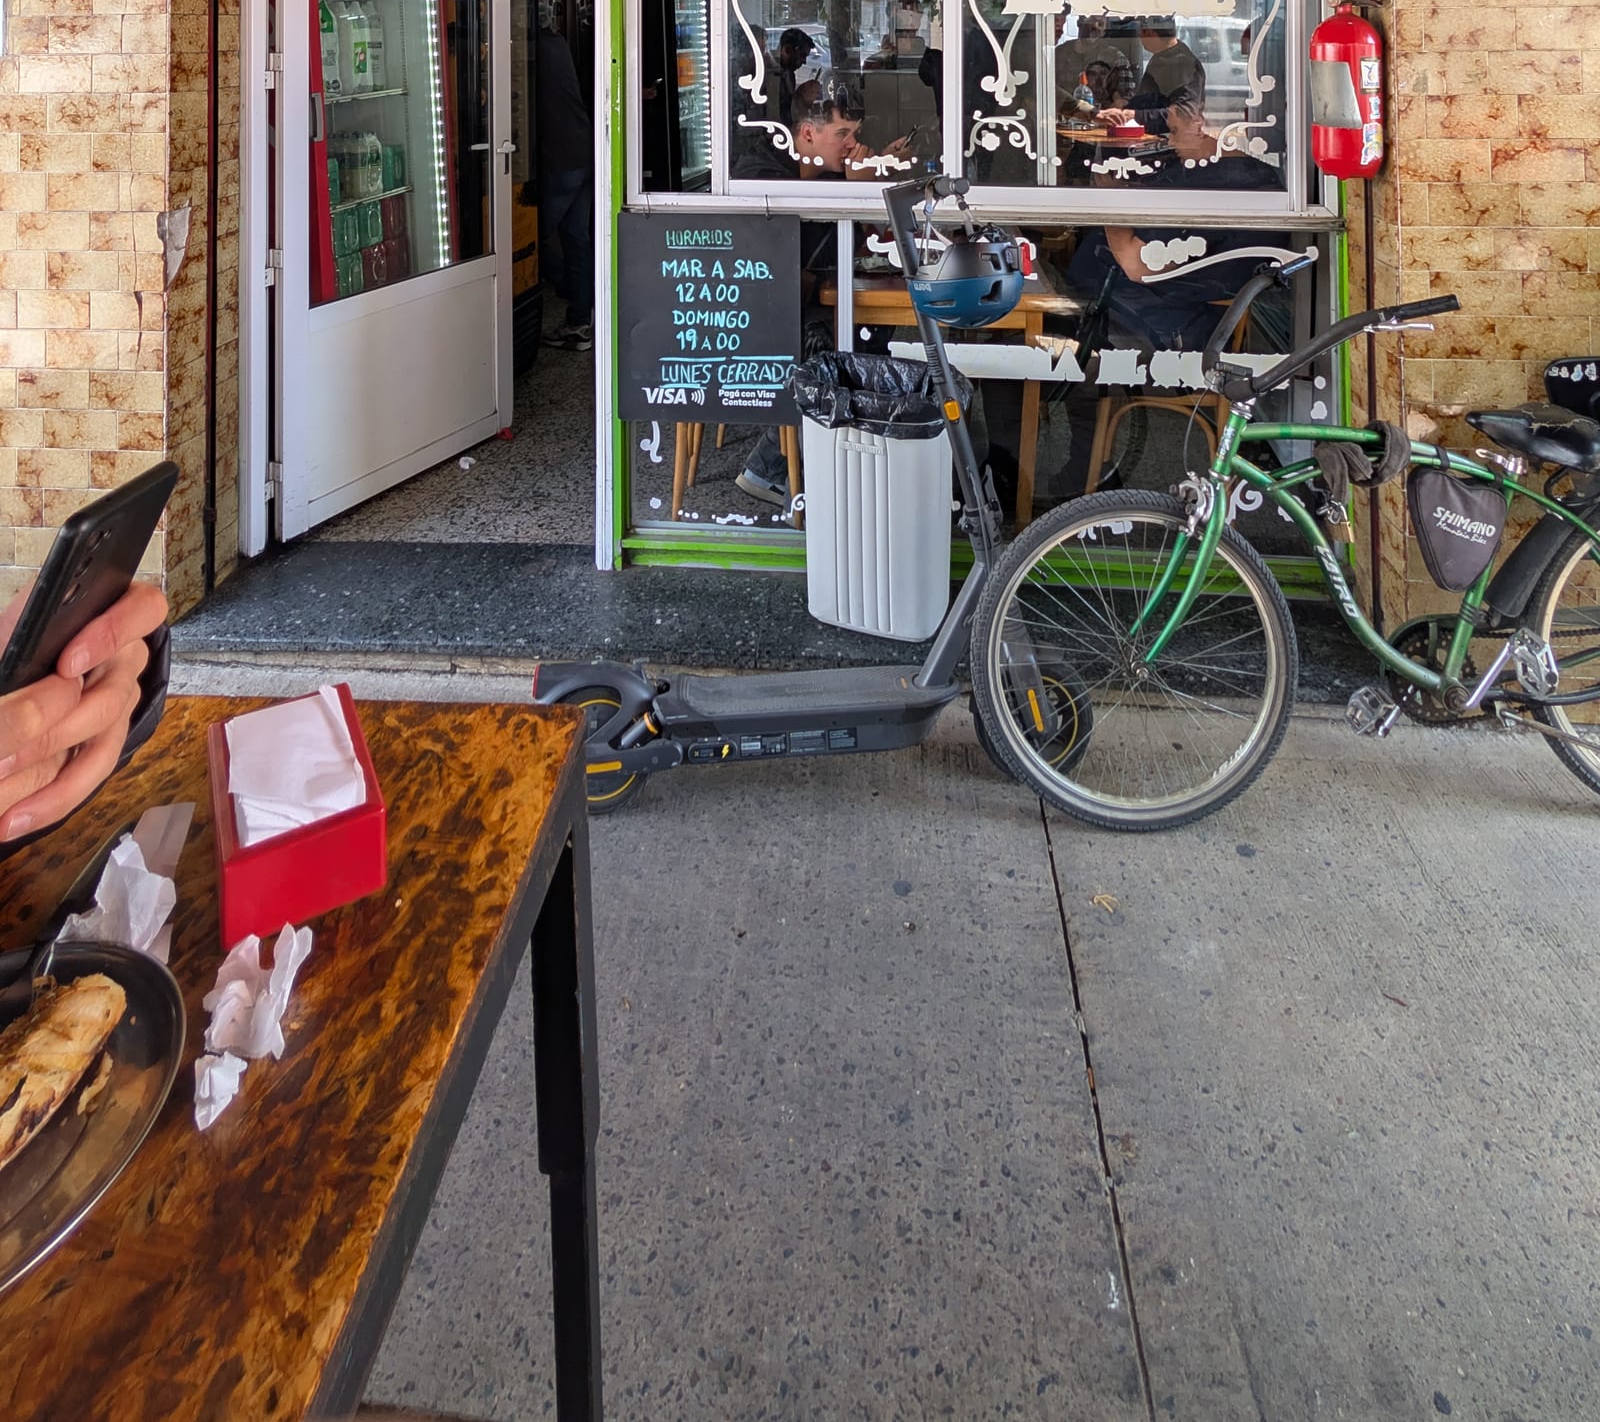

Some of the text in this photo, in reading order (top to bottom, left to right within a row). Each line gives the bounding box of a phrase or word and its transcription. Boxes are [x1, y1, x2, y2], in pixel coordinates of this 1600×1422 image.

[665, 230, 733, 246] HORARIOS
[661, 258, 774, 280] MAR A SAB.
[675, 283, 740, 303] 12 A 00
[672, 310, 750, 328] DOMINGO
[676, 329, 740, 350] 19 A 00
[661, 364, 712, 384] LUNES
[641, 387, 688, 405] VISA
[718, 389, 740, 399] Pagá
[757, 390, 776, 399] Visa
[722, 398, 772, 407] Contactless
[1432, 506, 1496, 537] SHIMANO
[1436, 520, 1470, 540] Mountain
